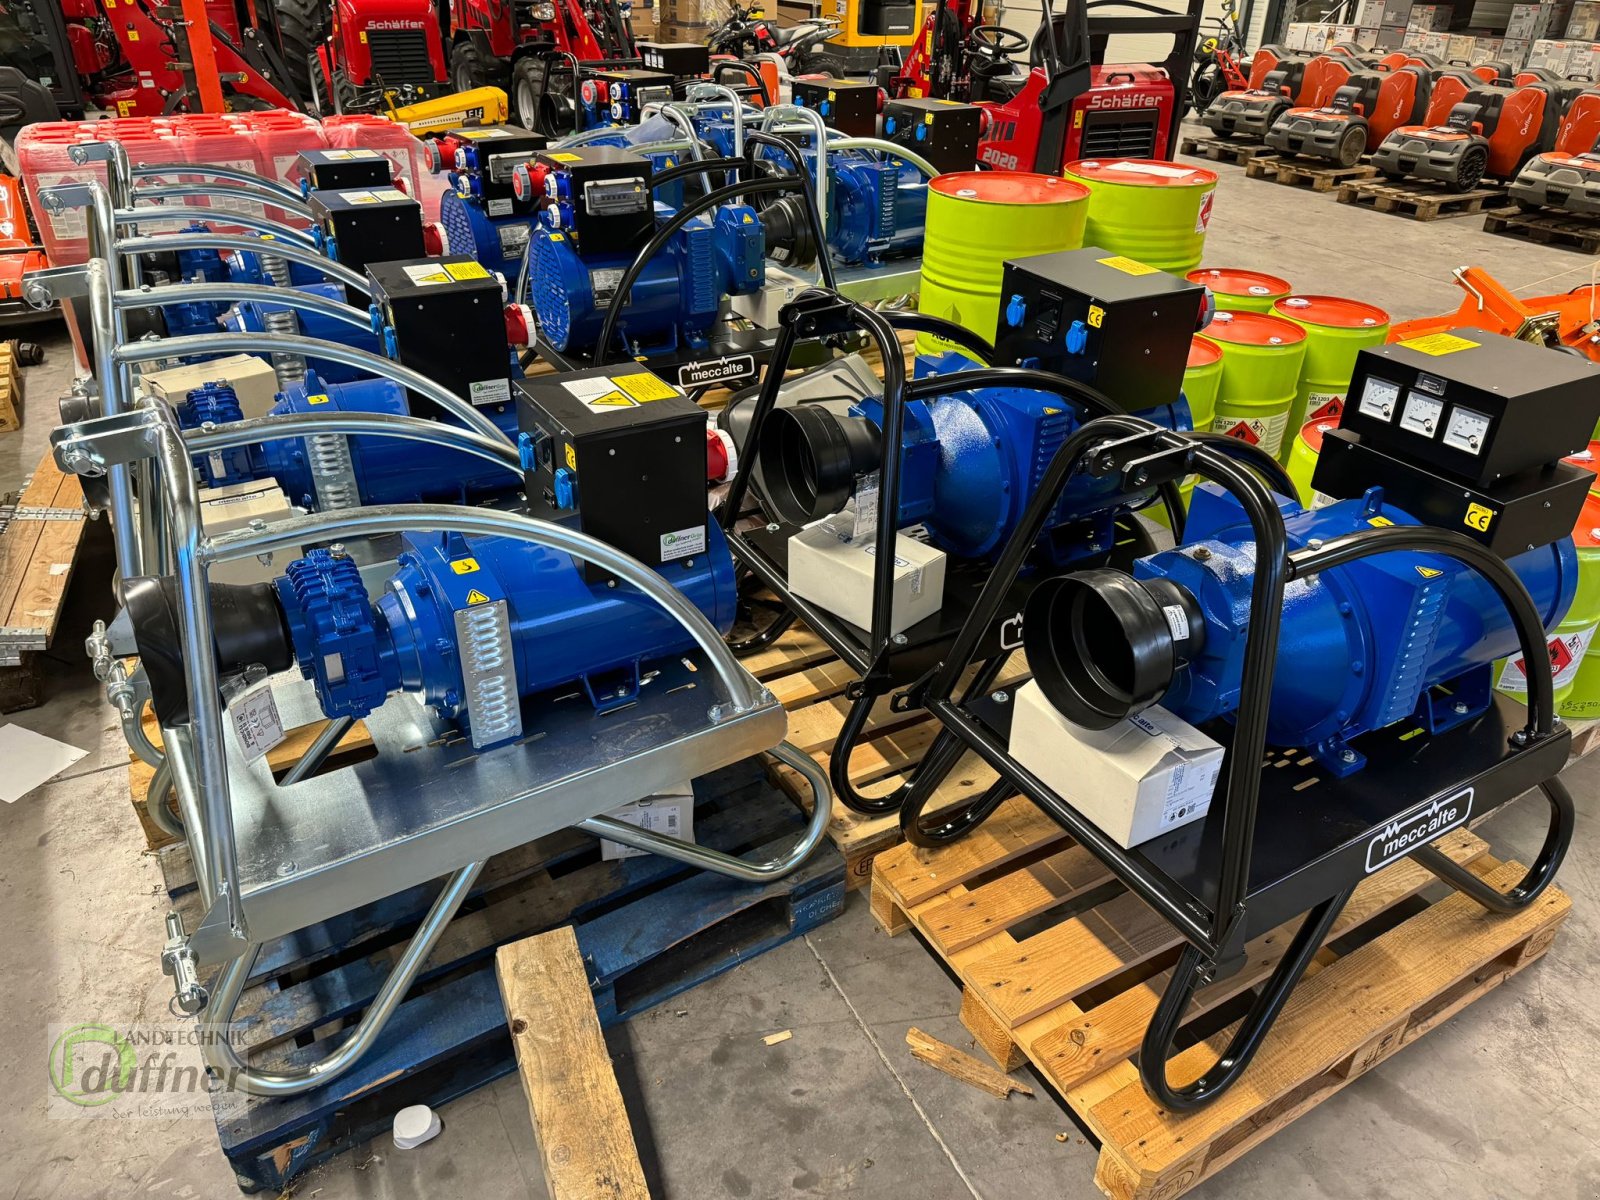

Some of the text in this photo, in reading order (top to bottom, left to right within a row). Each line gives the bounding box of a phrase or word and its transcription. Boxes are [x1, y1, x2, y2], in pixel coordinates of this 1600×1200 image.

[365, 20, 424, 30] Schäffer
[1086, 94, 1163, 109] Schäffer
[983, 147, 1018, 171] 2028
[691, 363, 744, 381] mecc alte
[1467, 510, 1489, 530] CE
[1383, 807, 1458, 857] mecc alte
